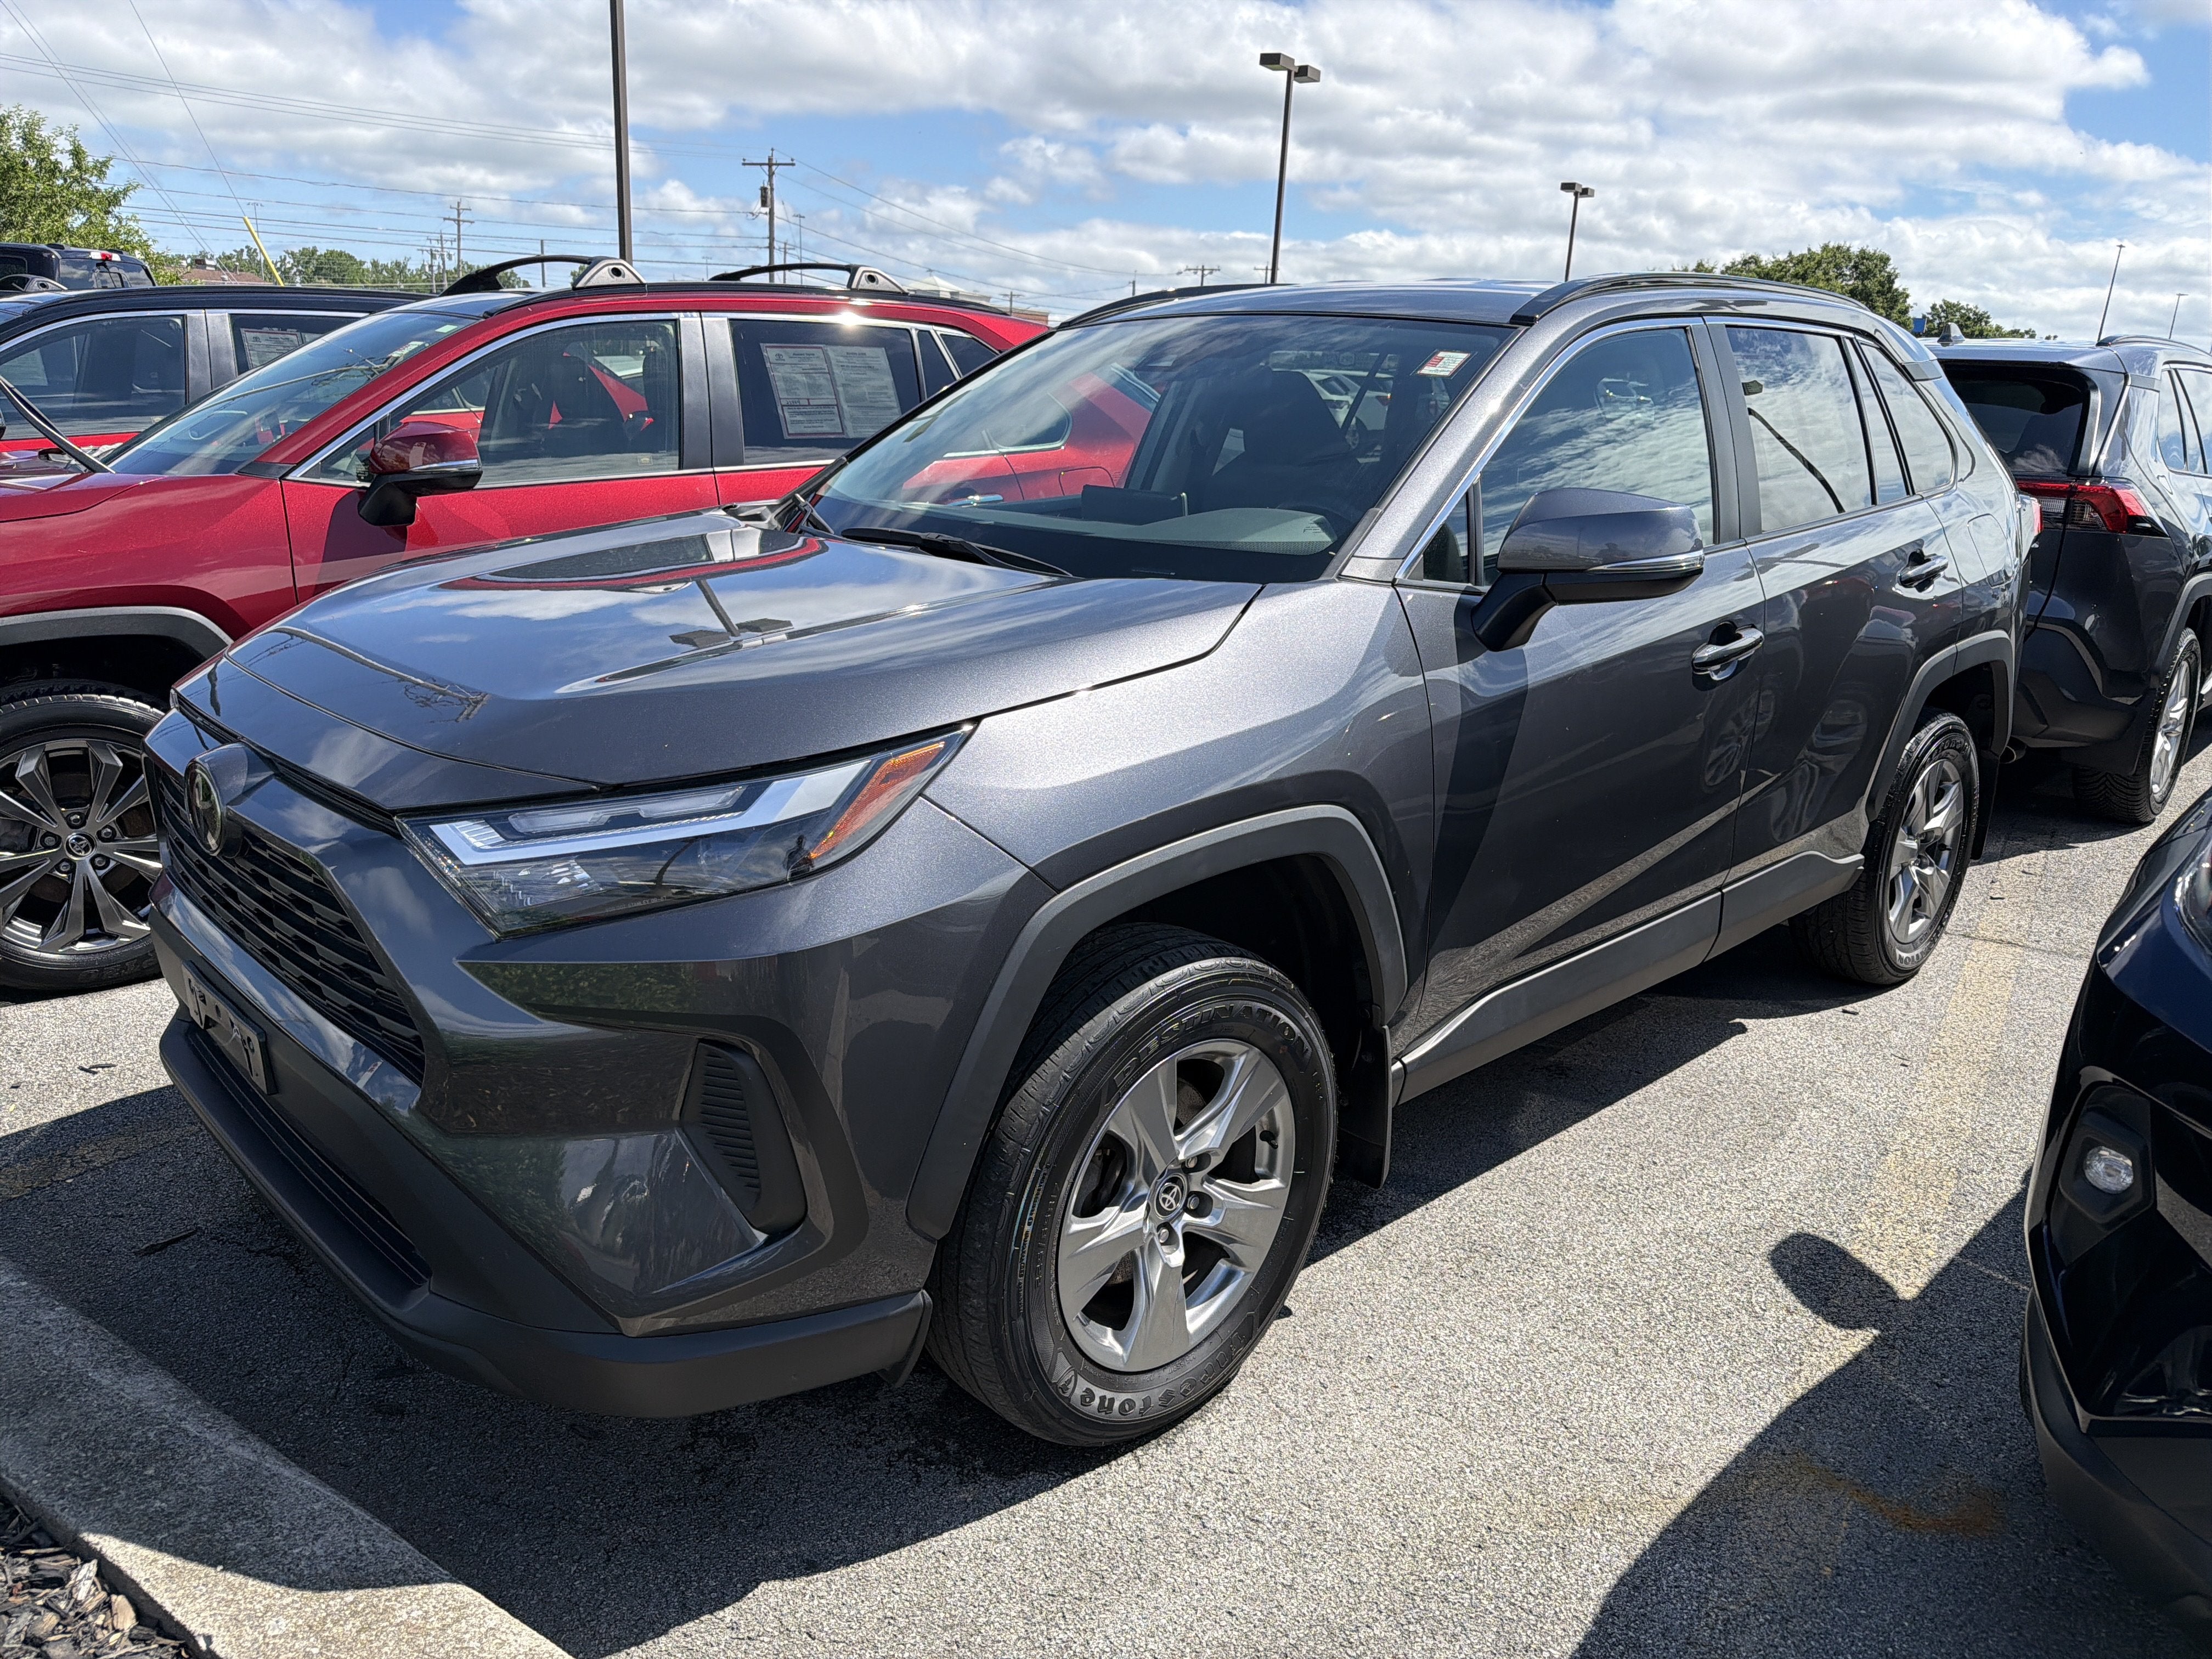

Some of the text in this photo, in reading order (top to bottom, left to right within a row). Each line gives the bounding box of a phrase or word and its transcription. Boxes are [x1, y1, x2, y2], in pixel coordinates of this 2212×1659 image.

[627, 899, 650, 908] STANLEY
[1113, 1003, 1312, 1087] DESTINATION
[1080, 1332, 1246, 1417] Firestone
